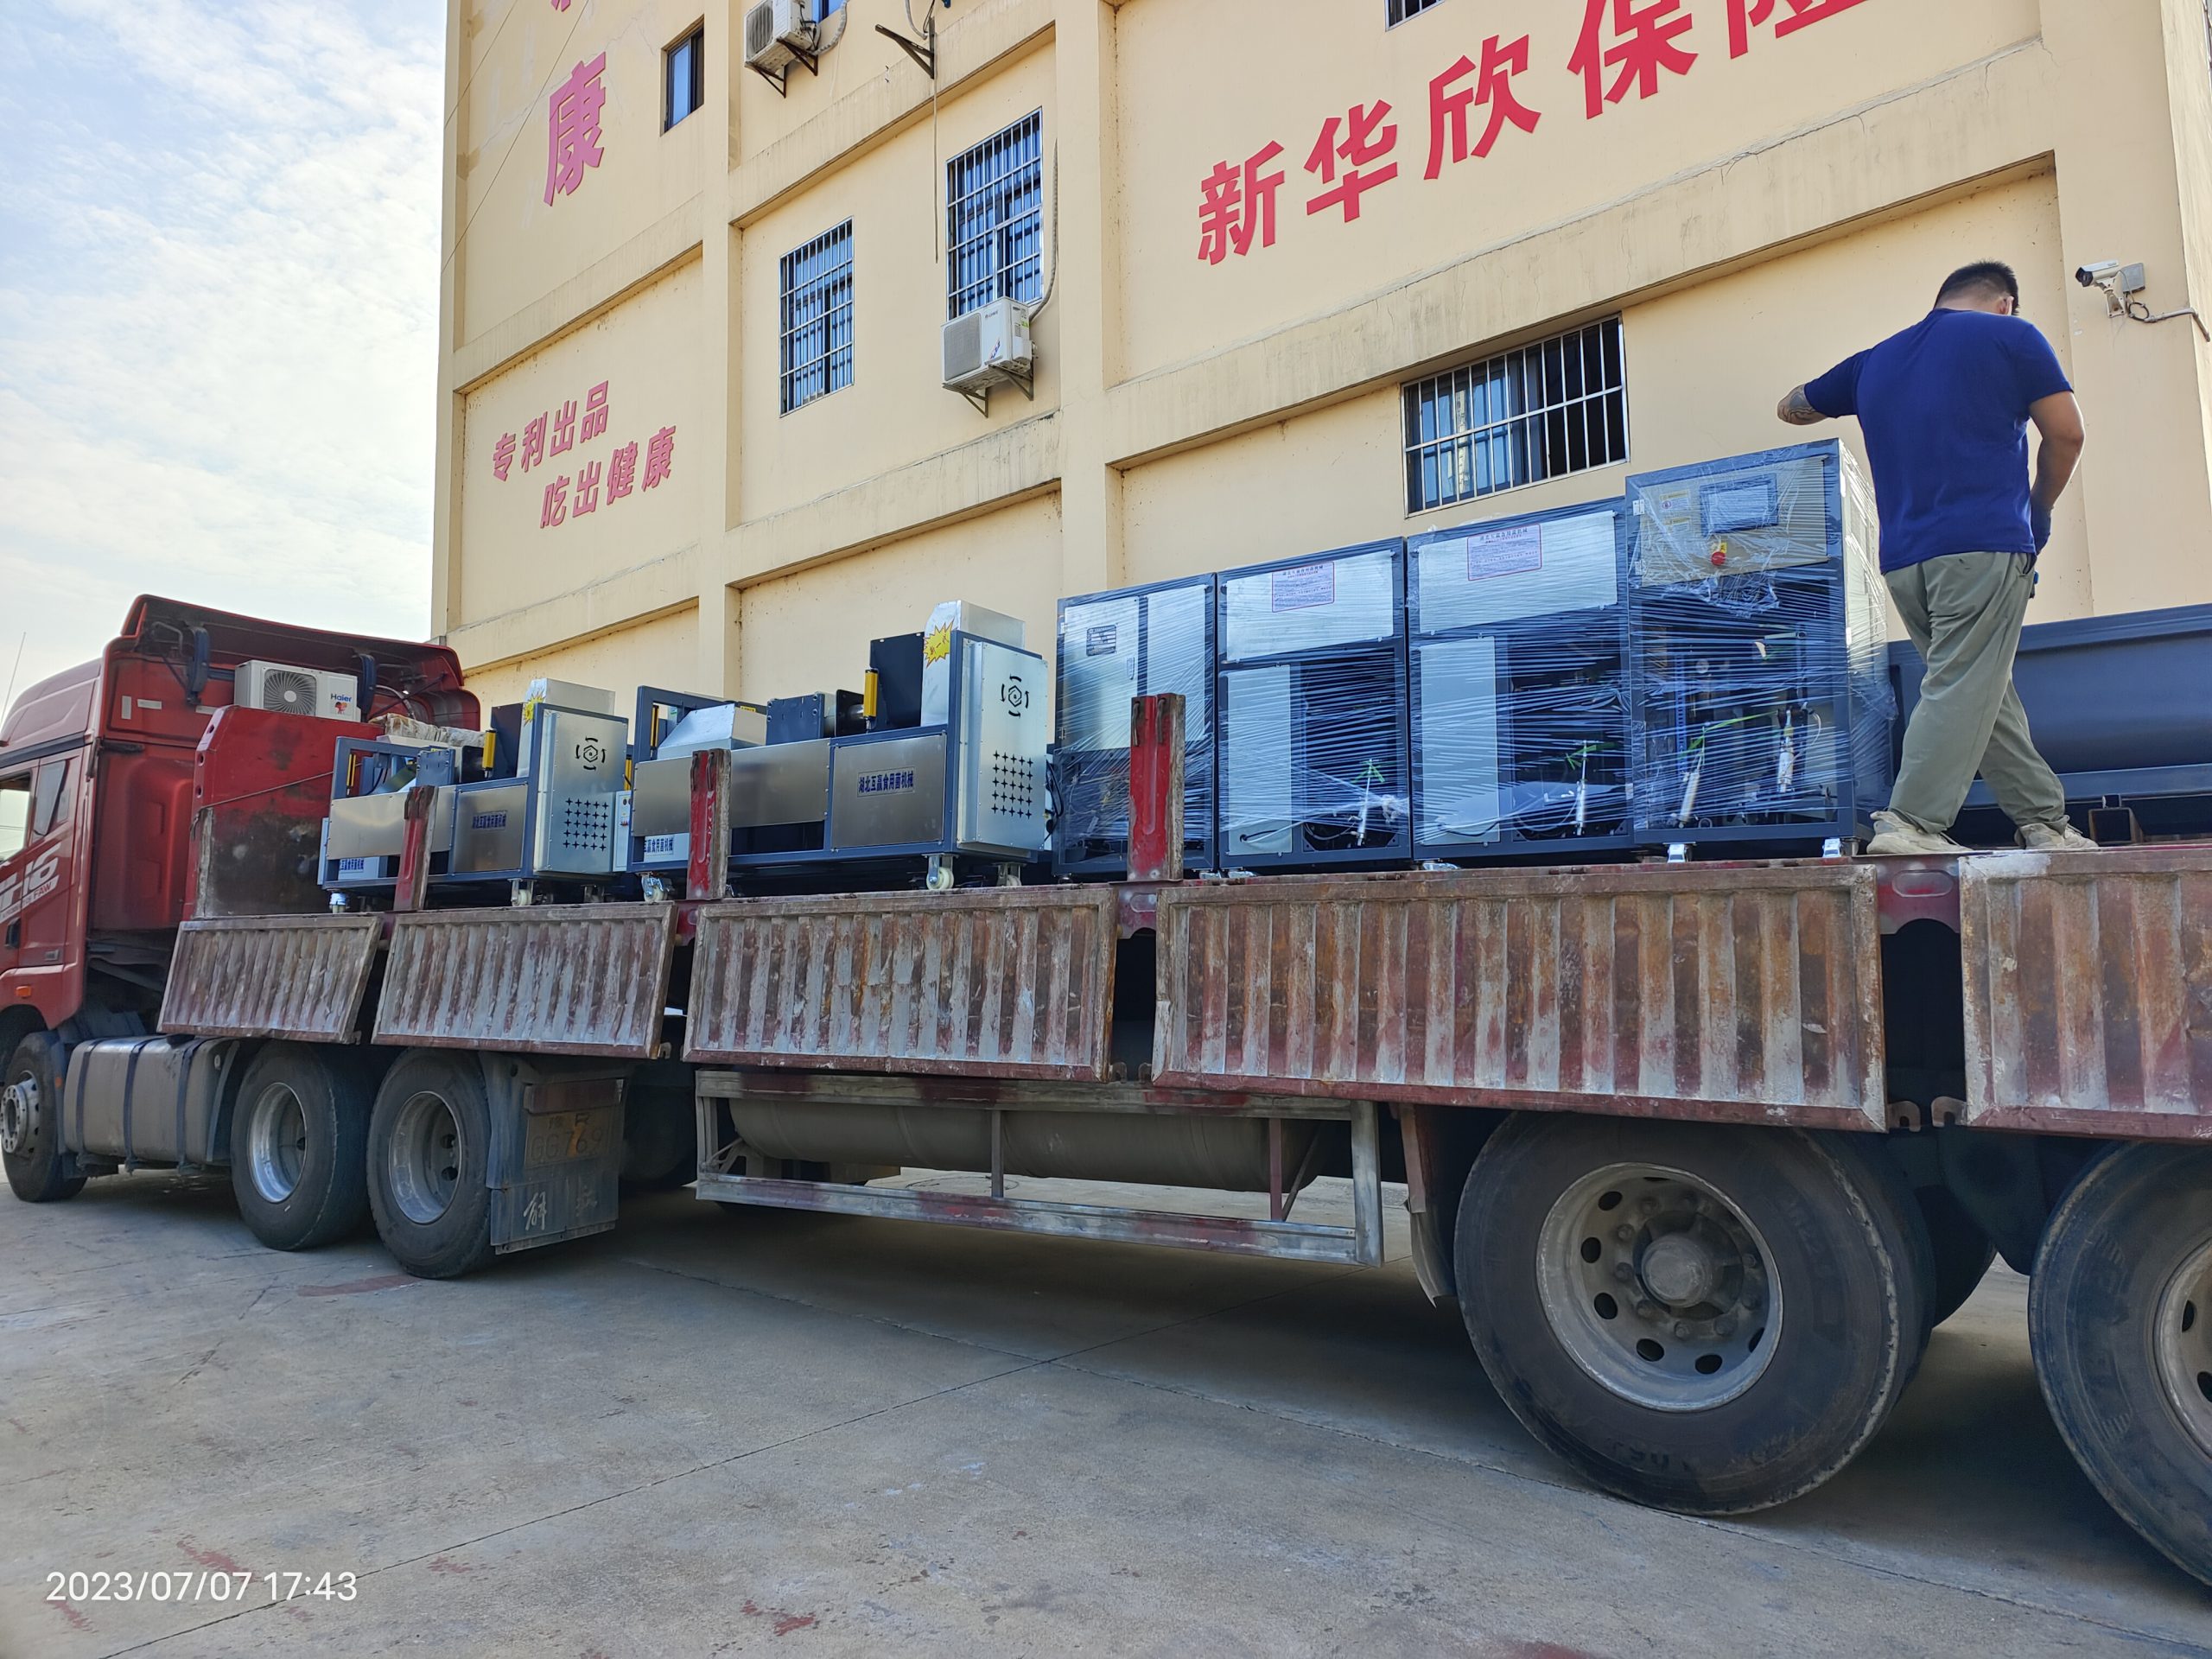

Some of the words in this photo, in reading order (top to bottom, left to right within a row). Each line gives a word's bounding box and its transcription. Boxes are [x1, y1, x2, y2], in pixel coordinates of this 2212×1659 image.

[492, 380, 609, 482] 专利出品
[539, 425, 677, 529] 吃出健康
[330, 693, 353, 702] Haier
[33, 880, 53, 900] FAW
